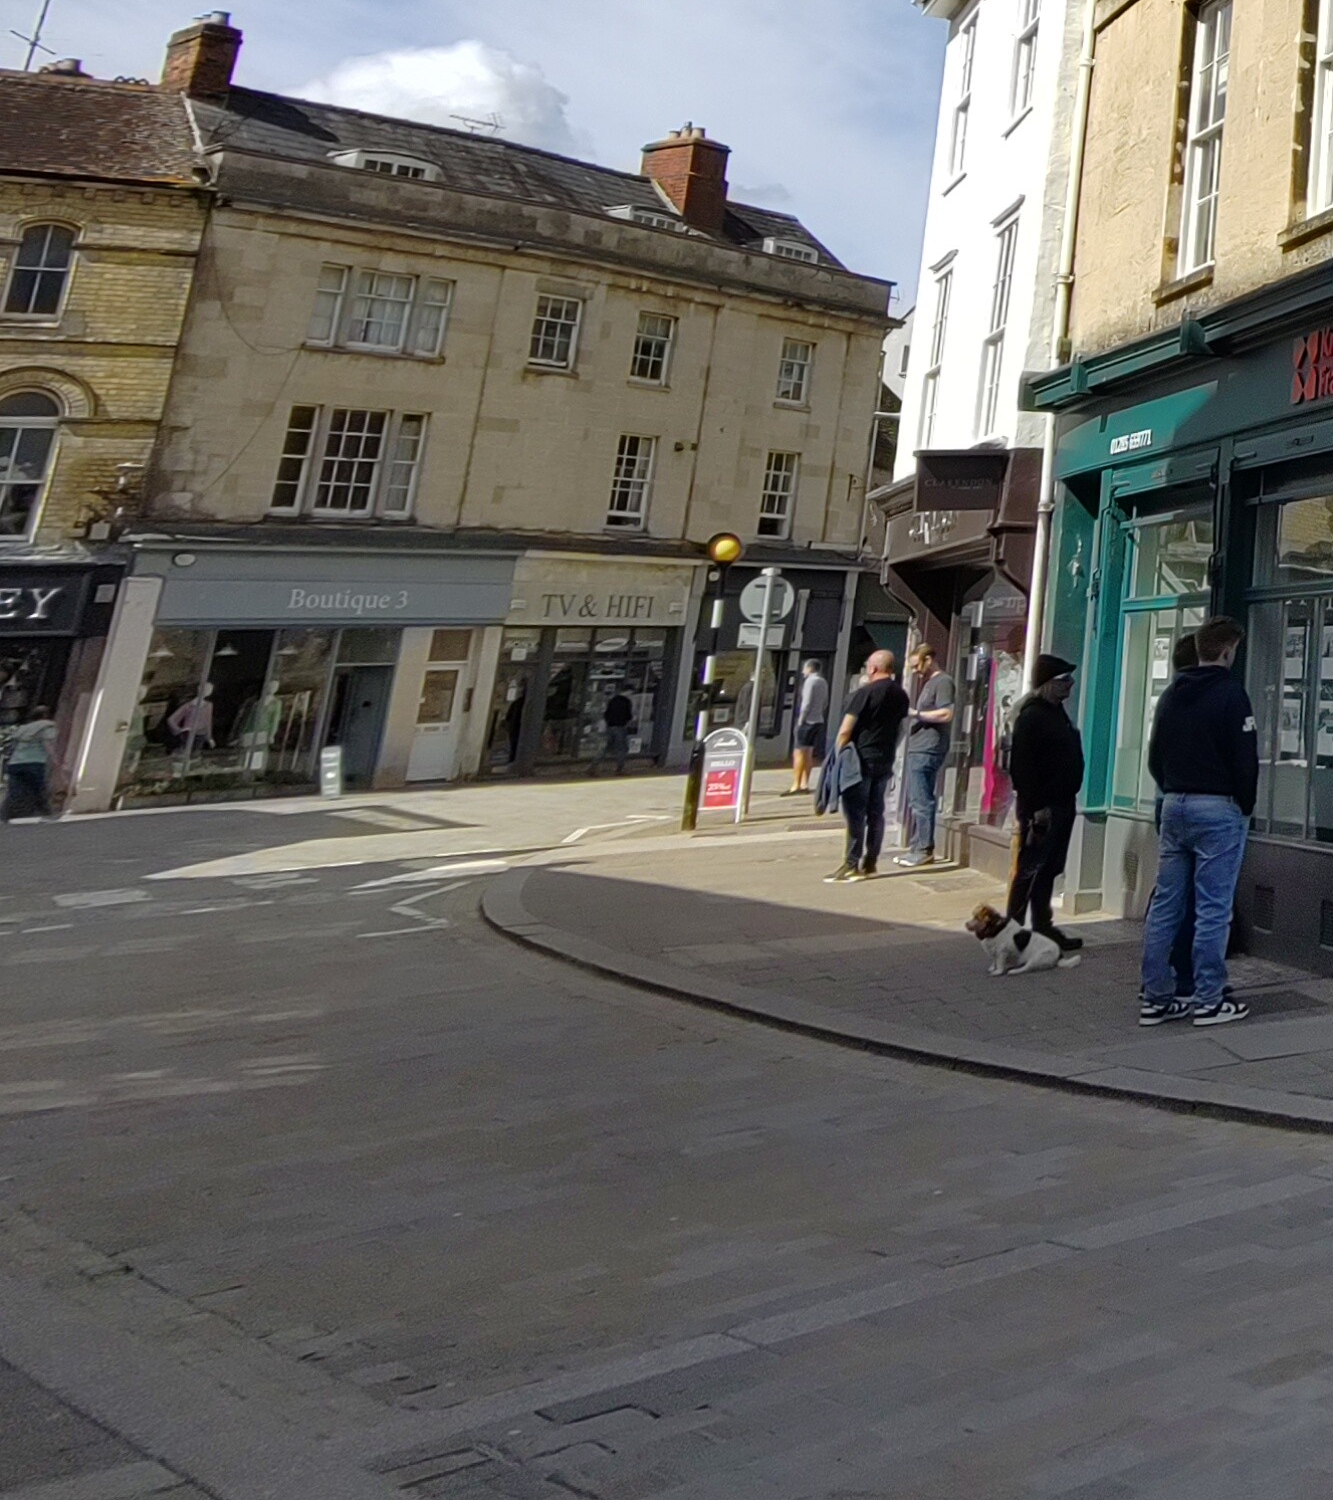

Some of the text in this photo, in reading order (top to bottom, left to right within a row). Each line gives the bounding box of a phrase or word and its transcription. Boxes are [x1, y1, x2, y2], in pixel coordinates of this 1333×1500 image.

[287, 588, 409, 615] Boutique 3
[542, 593, 656, 619] TV & HIFI
